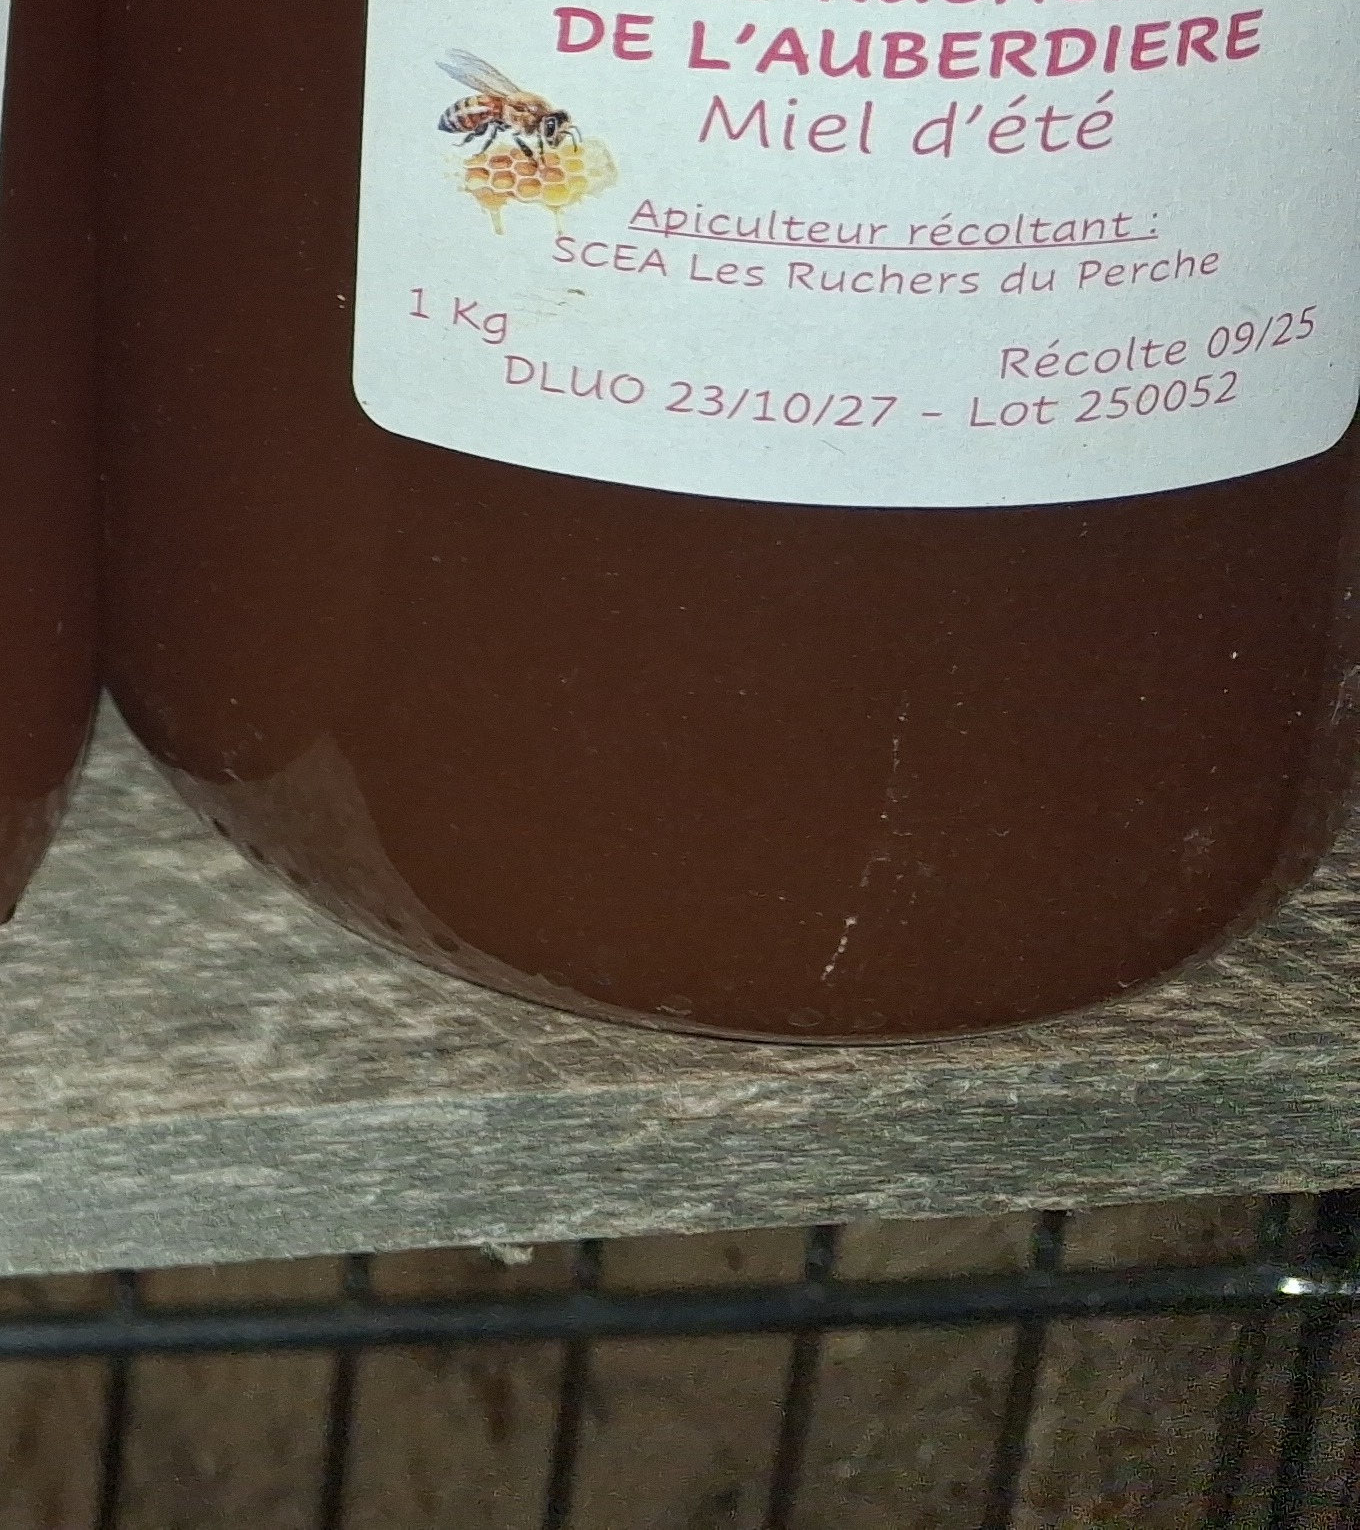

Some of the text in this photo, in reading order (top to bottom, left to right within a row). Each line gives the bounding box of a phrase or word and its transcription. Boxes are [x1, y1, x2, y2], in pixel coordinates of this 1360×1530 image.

[553, 6, 654, 60] DE
[698, 93, 874, 156] Miel
[627, 198, 889, 246] Apiculteur
[908, 208, 1132, 247] récoltant
[552, 236, 1221, 296] SCEA Les Ruchers du Perche
[408, 287, 510, 344] 1 Kg
[999, 306, 1317, 379] Récolte 09/25
[503, 354, 645, 405] DLUO
[664, 381, 896, 430] 23/10/27
[970, 393, 1059, 430] Lot
[1075, 372, 1240, 423] 250052
